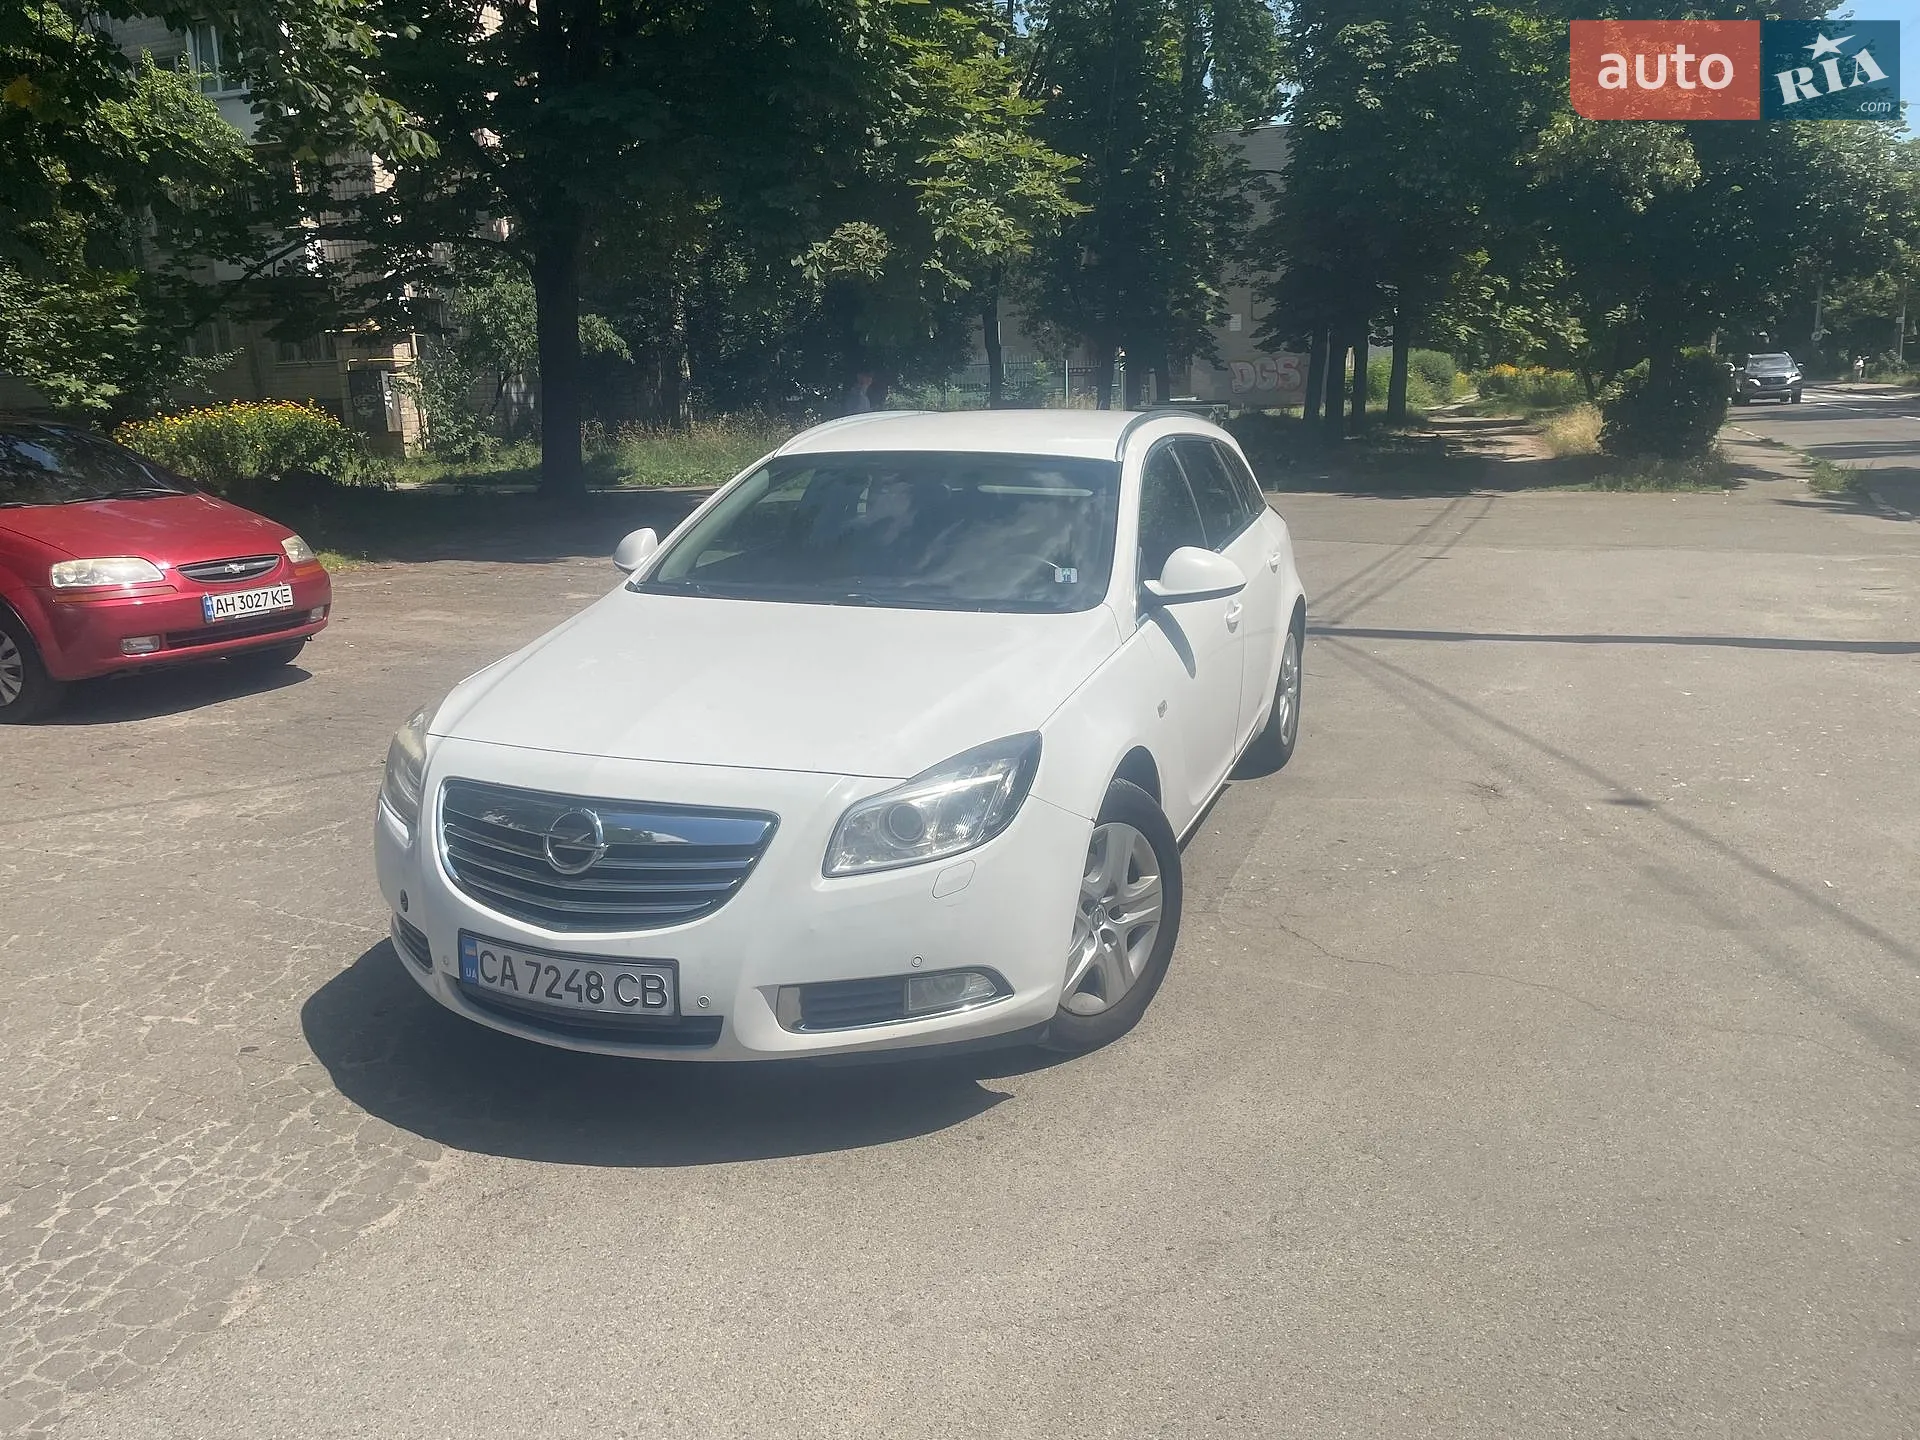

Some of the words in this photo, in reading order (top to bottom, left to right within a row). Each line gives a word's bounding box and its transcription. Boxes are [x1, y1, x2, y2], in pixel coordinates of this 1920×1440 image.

[216, 597, 236, 615] AH
[237, 592, 269, 610] 3027
[270, 588, 291, 606] KE
[465, 967, 477, 980] UA
[479, 950, 519, 991] CA
[525, 960, 605, 1004] 7248
[614, 973, 669, 1009] CB
